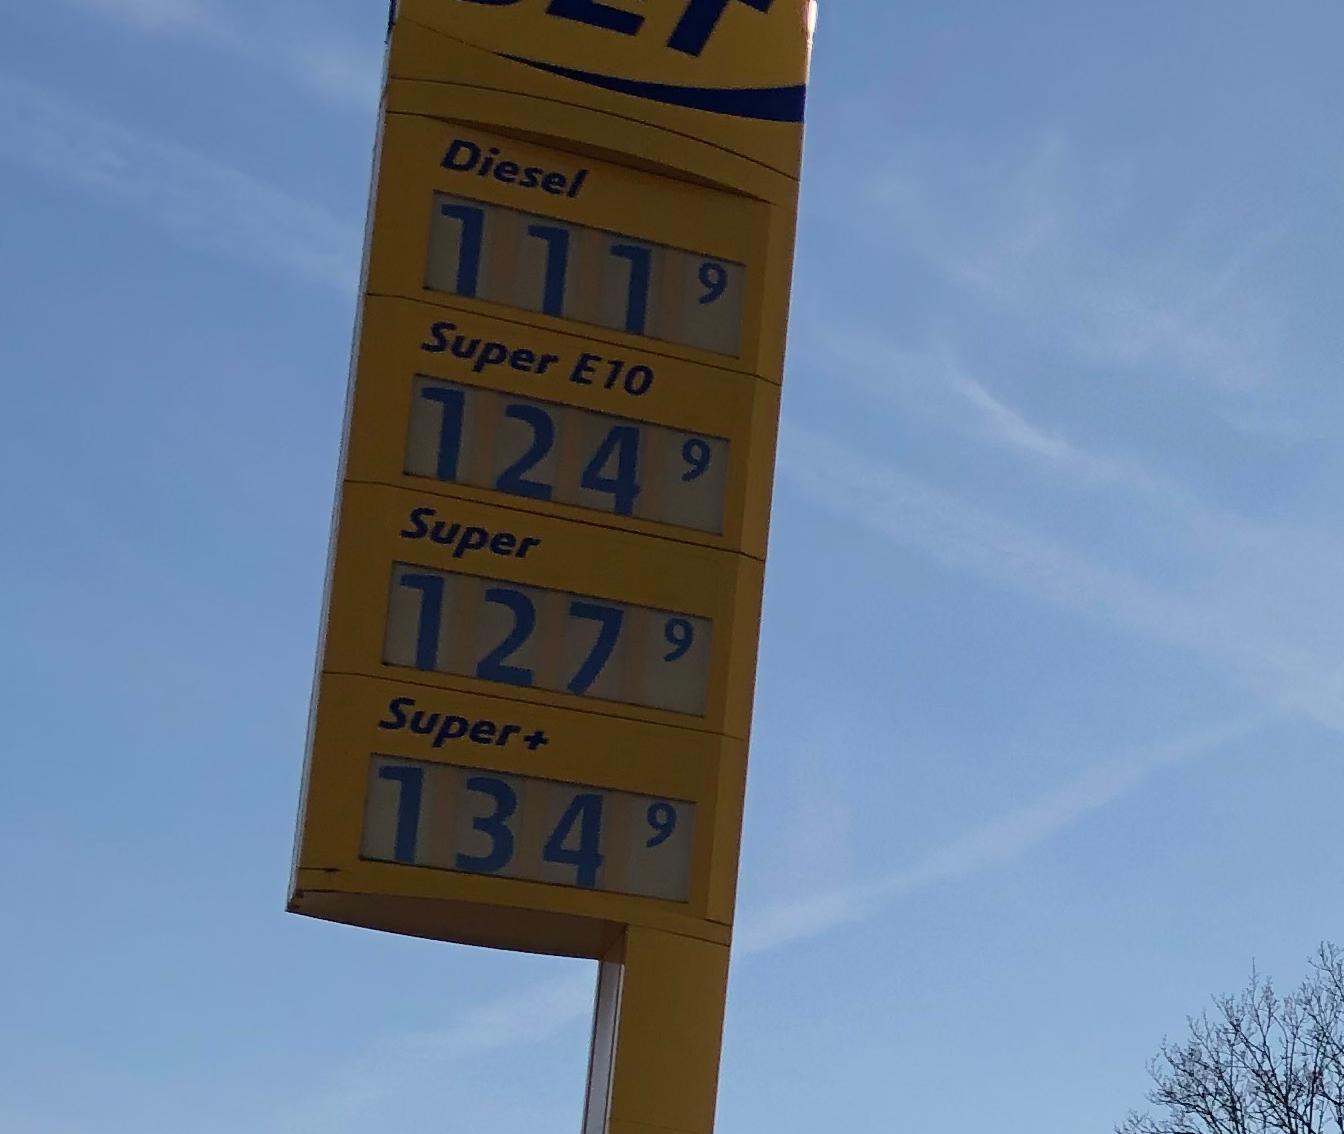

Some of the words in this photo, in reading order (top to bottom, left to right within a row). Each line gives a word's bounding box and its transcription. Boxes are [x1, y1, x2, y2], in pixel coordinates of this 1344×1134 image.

[440, 139, 589, 200] Diesel
[421, 321, 560, 373] Super
[569, 352, 654, 396] E10
[400, 507, 541, 559] Super
[378, 697, 550, 751] Super+
